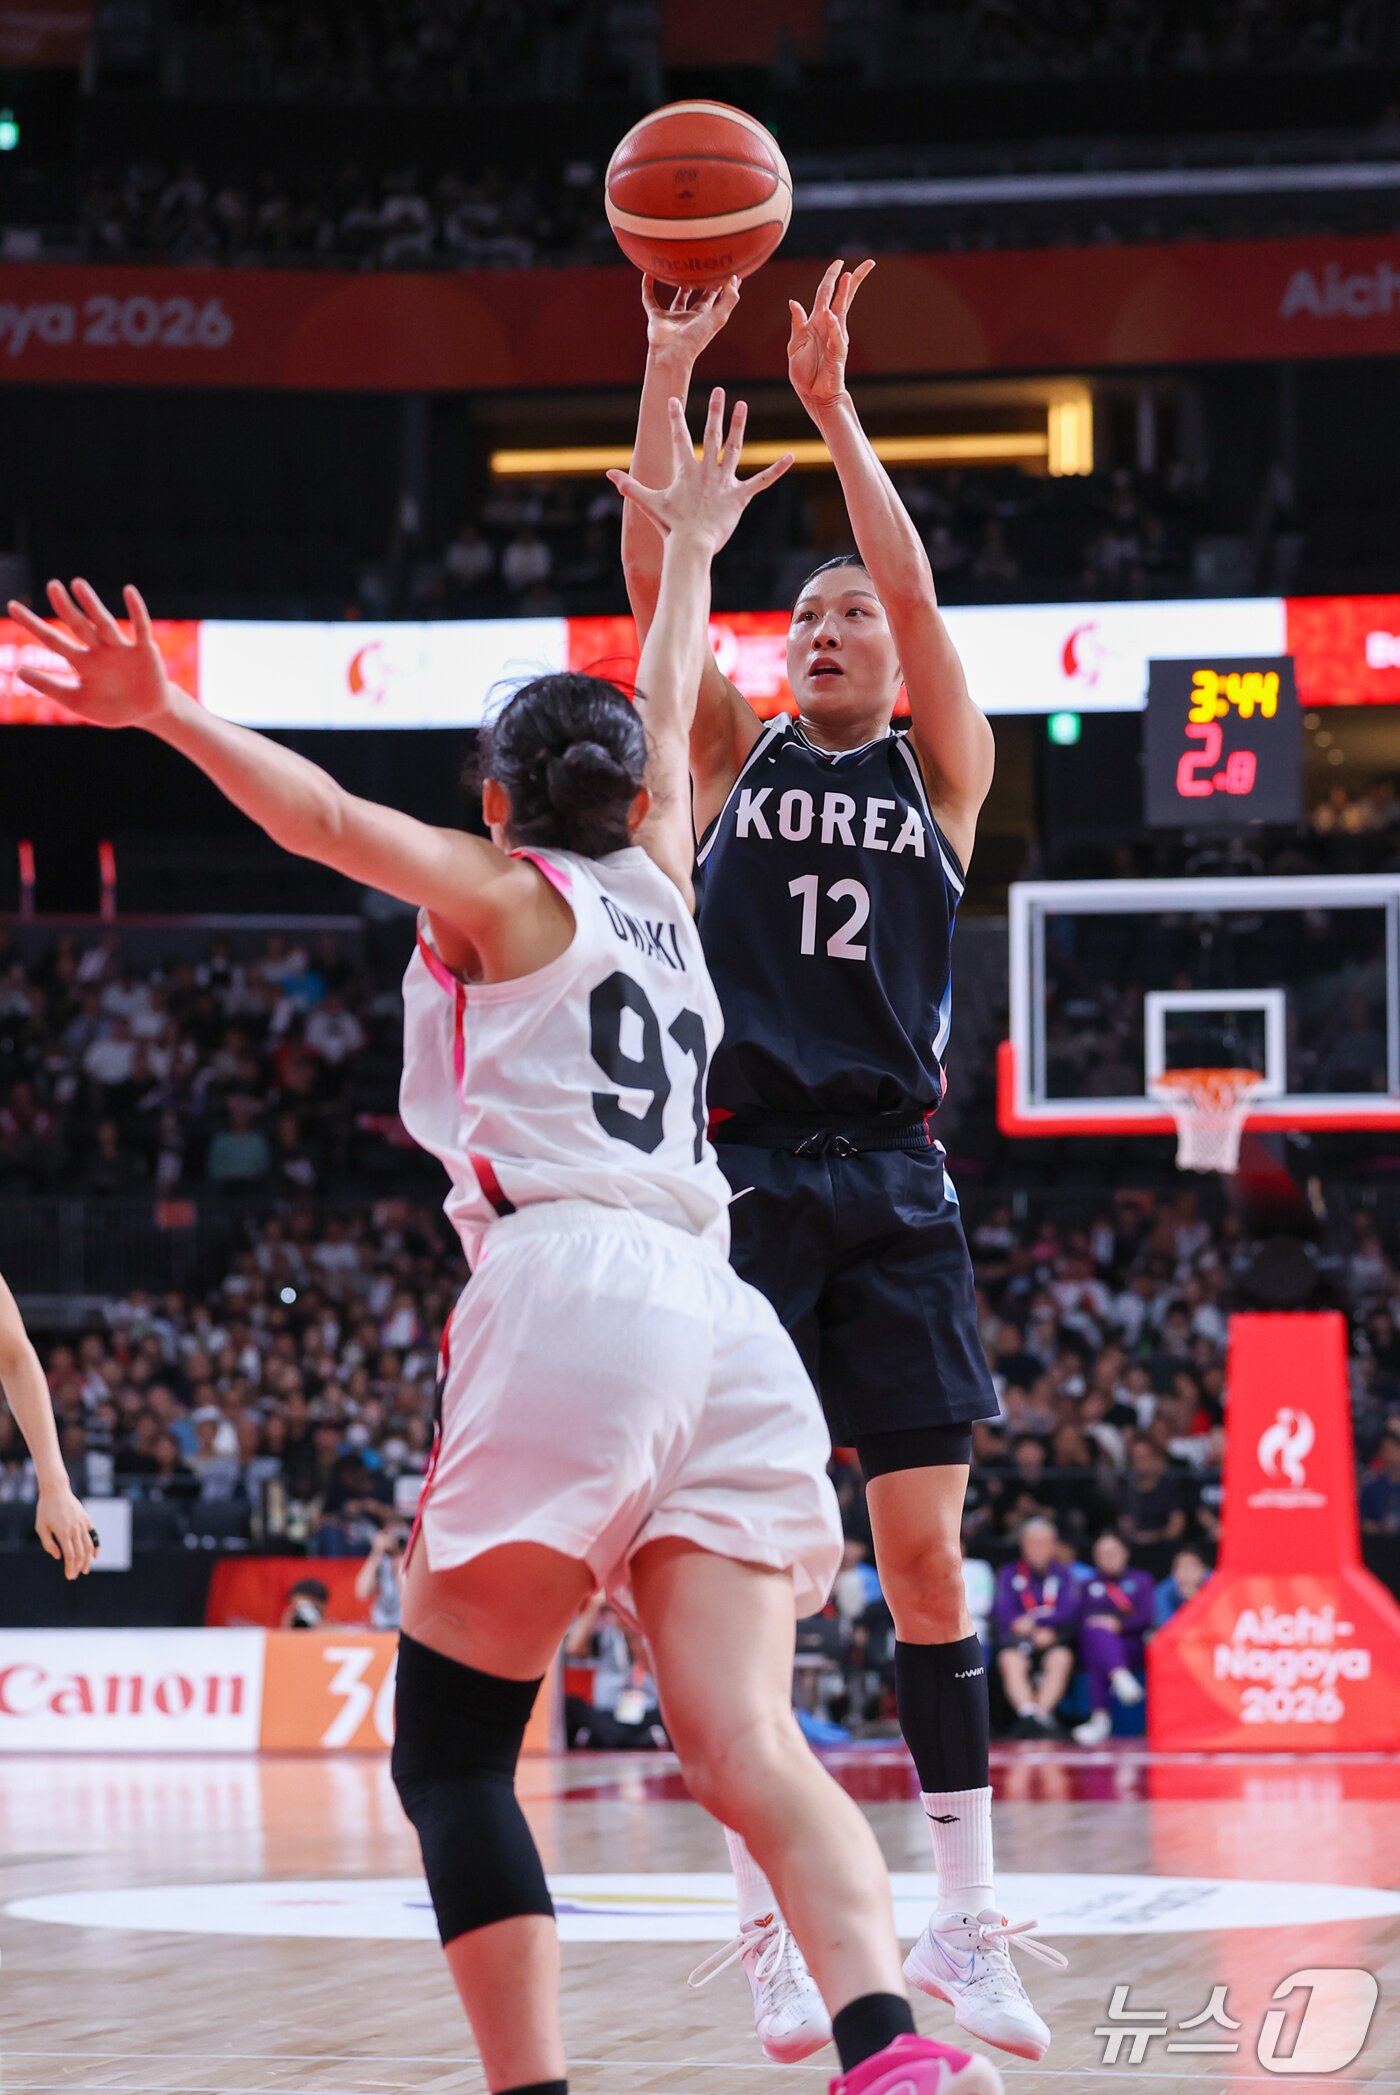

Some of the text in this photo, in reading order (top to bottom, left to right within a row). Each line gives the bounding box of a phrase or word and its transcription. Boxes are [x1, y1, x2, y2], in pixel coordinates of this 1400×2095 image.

[0, 295, 233, 356] ya 2026
[1189, 670, 1280, 723] 3:44
[735, 787, 926, 858] KOREA
[788, 873, 870, 961] 12
[589, 971, 708, 1165] 91
[1231, 1605, 1355, 1646] Aichi-
[0, 1661, 246, 1718] Canon
[1214, 1644, 1371, 1688] Nagoya
[1240, 1686, 1345, 1724] 2026
